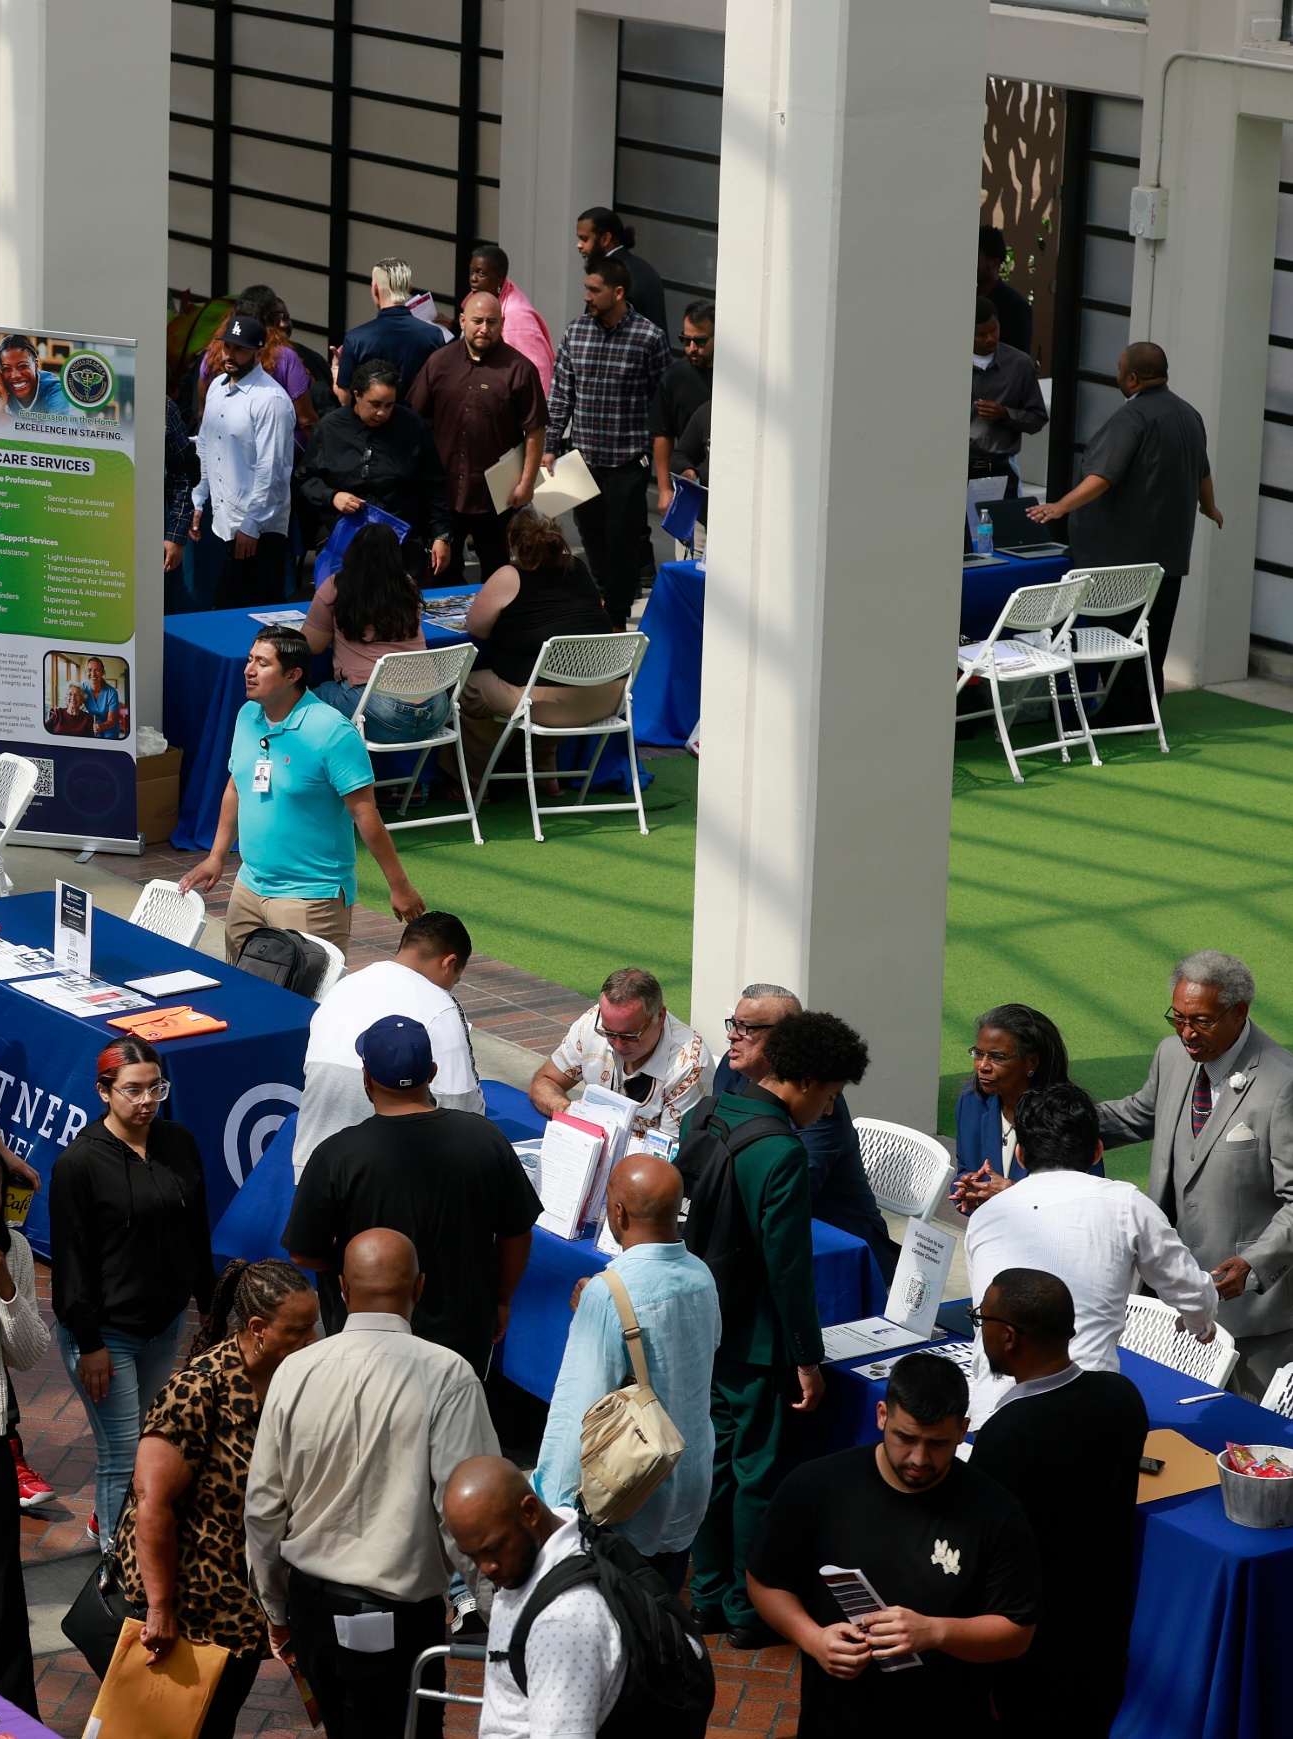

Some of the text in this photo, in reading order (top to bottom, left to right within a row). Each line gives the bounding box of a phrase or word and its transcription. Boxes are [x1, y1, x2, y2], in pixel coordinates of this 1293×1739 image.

[14, 421, 124, 441] EXCELLENCE IN STAFFING.
[30, 455, 90, 472] SERVICES
[5, 475, 52, 487] Professionals
[47, 494, 115, 508] Senior Care Assistant
[47, 505, 109, 518] Home Support Aide
[0, 533, 28, 543] Support
[29, 536, 59, 547] Services
[47, 553, 110, 567] Light Housekeeping
[47, 563, 126, 578] Transportation & Errands
[47, 574, 126, 588] Respite Care for Families
[47, 585, 78, 595] Dementia
[78, 588, 84, 596] &
[43, 595, 80, 605] Supervision
[47, 606, 68, 616] Hourly
[68, 608, 75, 616] &
[43, 616, 85, 627] Care Options
[914, 1231, 933, 1244] Subscribe
